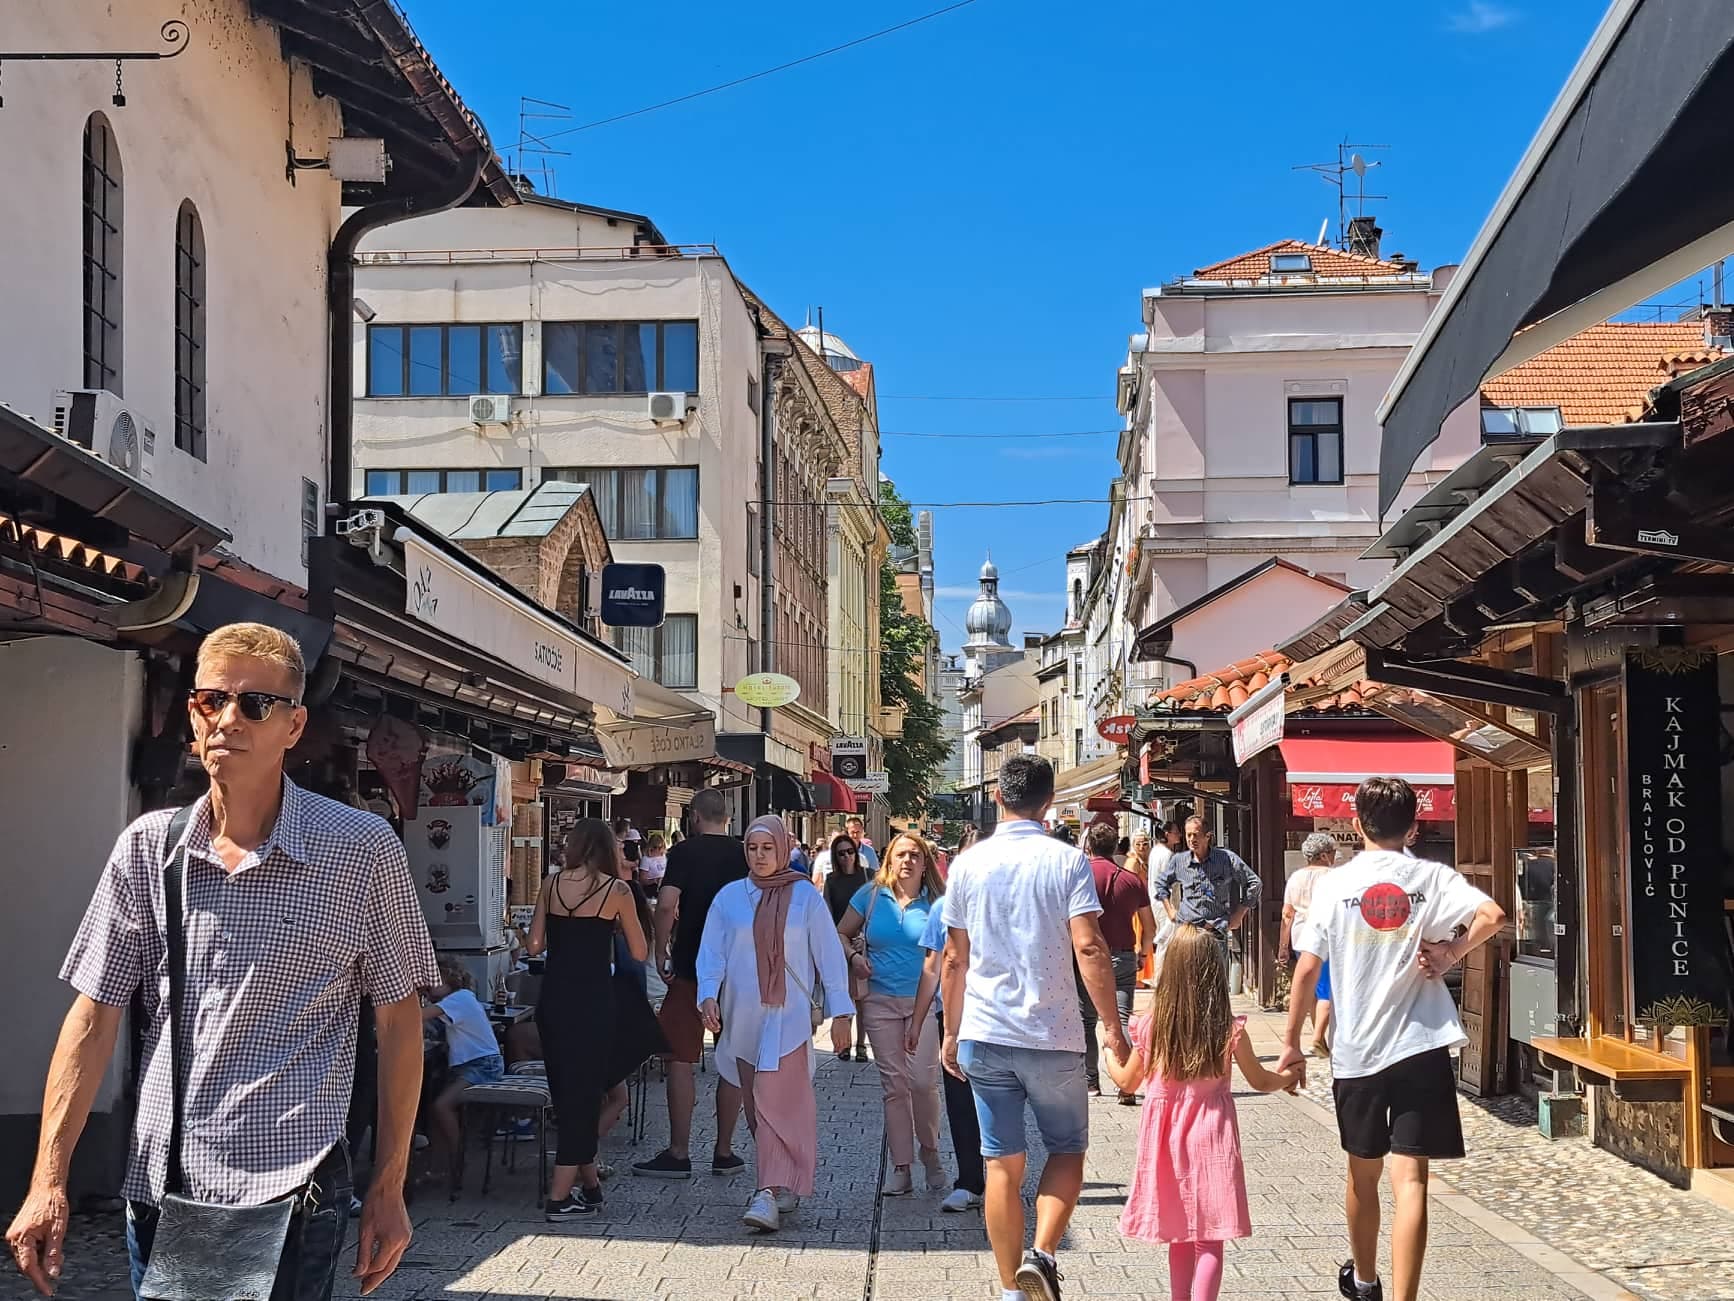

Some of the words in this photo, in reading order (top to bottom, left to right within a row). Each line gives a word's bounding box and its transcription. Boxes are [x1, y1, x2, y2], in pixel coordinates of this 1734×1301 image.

[608, 587, 655, 601] LAVAZZA
[836, 740, 864, 749] LAVAZZA
[1663, 697, 1688, 807] KAJMAK
[1062, 807, 1074, 815] dm
[1642, 774, 1655, 897] BRAJLOVIĆ
[1666, 818, 1686, 853] OD
[1668, 864, 1689, 976] PUNICE
